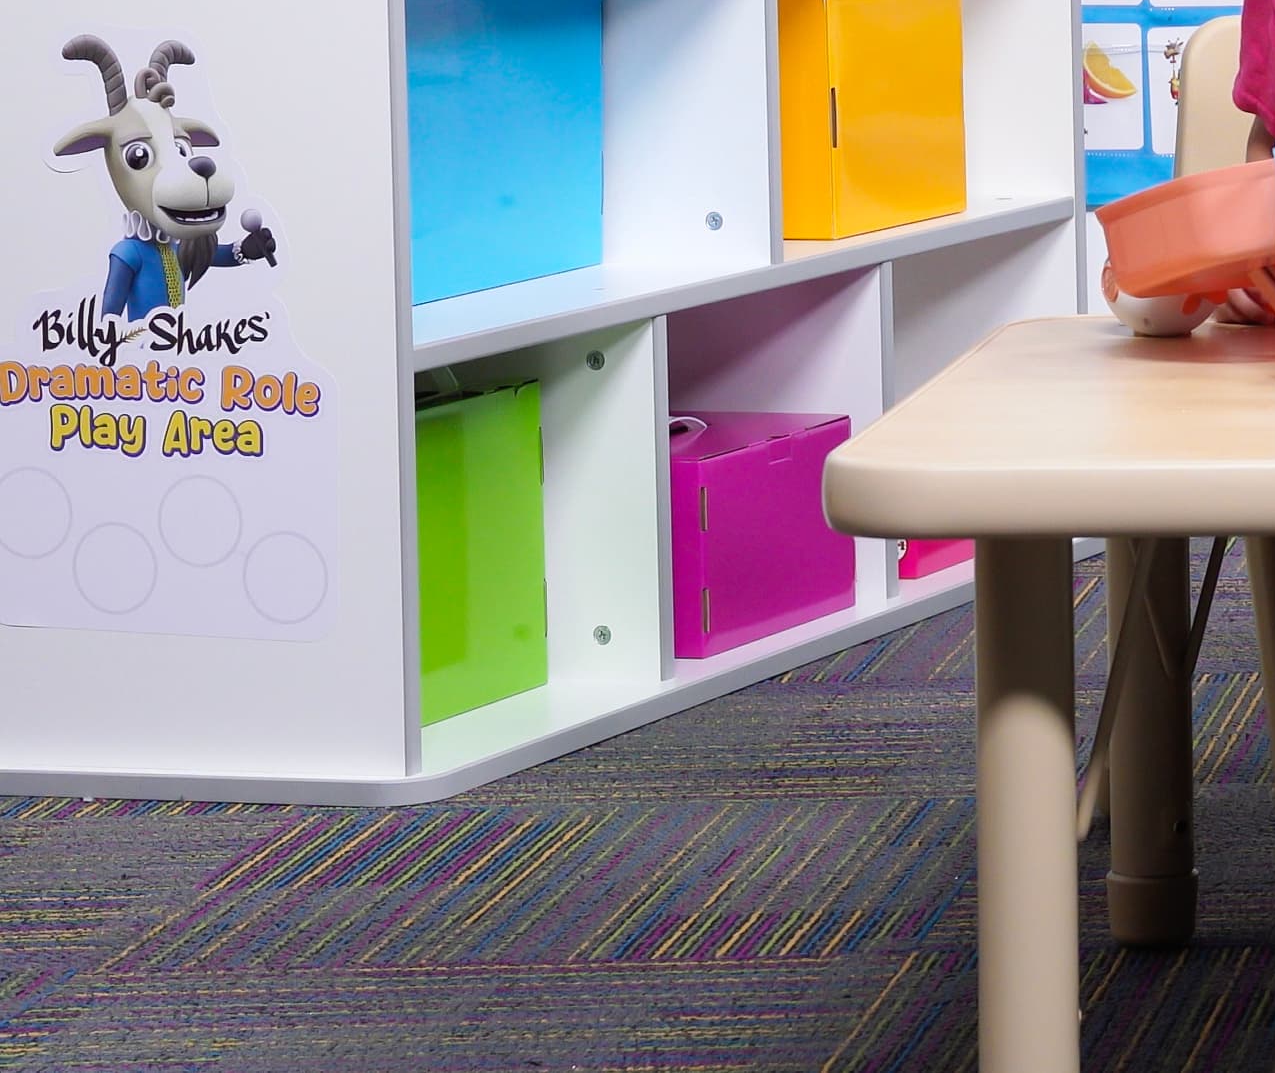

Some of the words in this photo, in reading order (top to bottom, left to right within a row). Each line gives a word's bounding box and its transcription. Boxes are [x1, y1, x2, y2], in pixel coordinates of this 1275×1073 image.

[32, 293, 123, 367] Billy
[0, 359, 206, 406] Dramatic
[219, 364, 322, 418] Role
[49, 403, 147, 457] Play
[161, 409, 265, 458] Area
